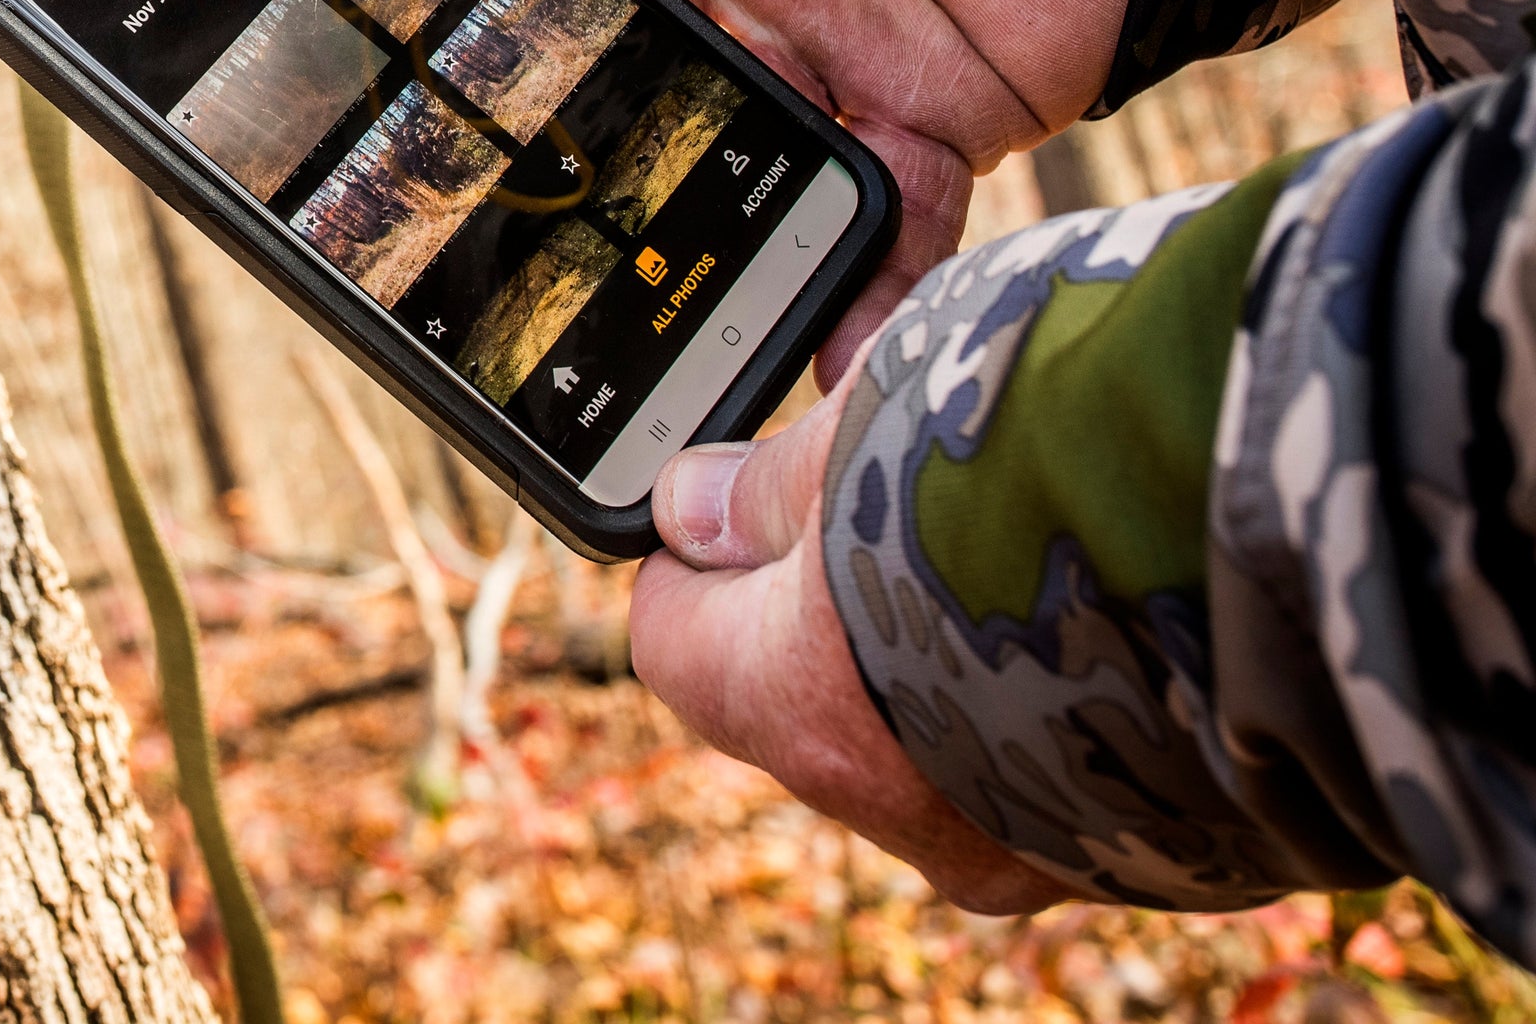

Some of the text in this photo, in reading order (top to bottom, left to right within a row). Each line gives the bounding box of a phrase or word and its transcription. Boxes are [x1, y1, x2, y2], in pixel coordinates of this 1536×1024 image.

[122, 0, 156, 34] Nov
[741, 153, 790, 218] ACCOUNT
[651, 253, 716, 335] ALL PHOTOS
[577, 382, 616, 428] HOME
